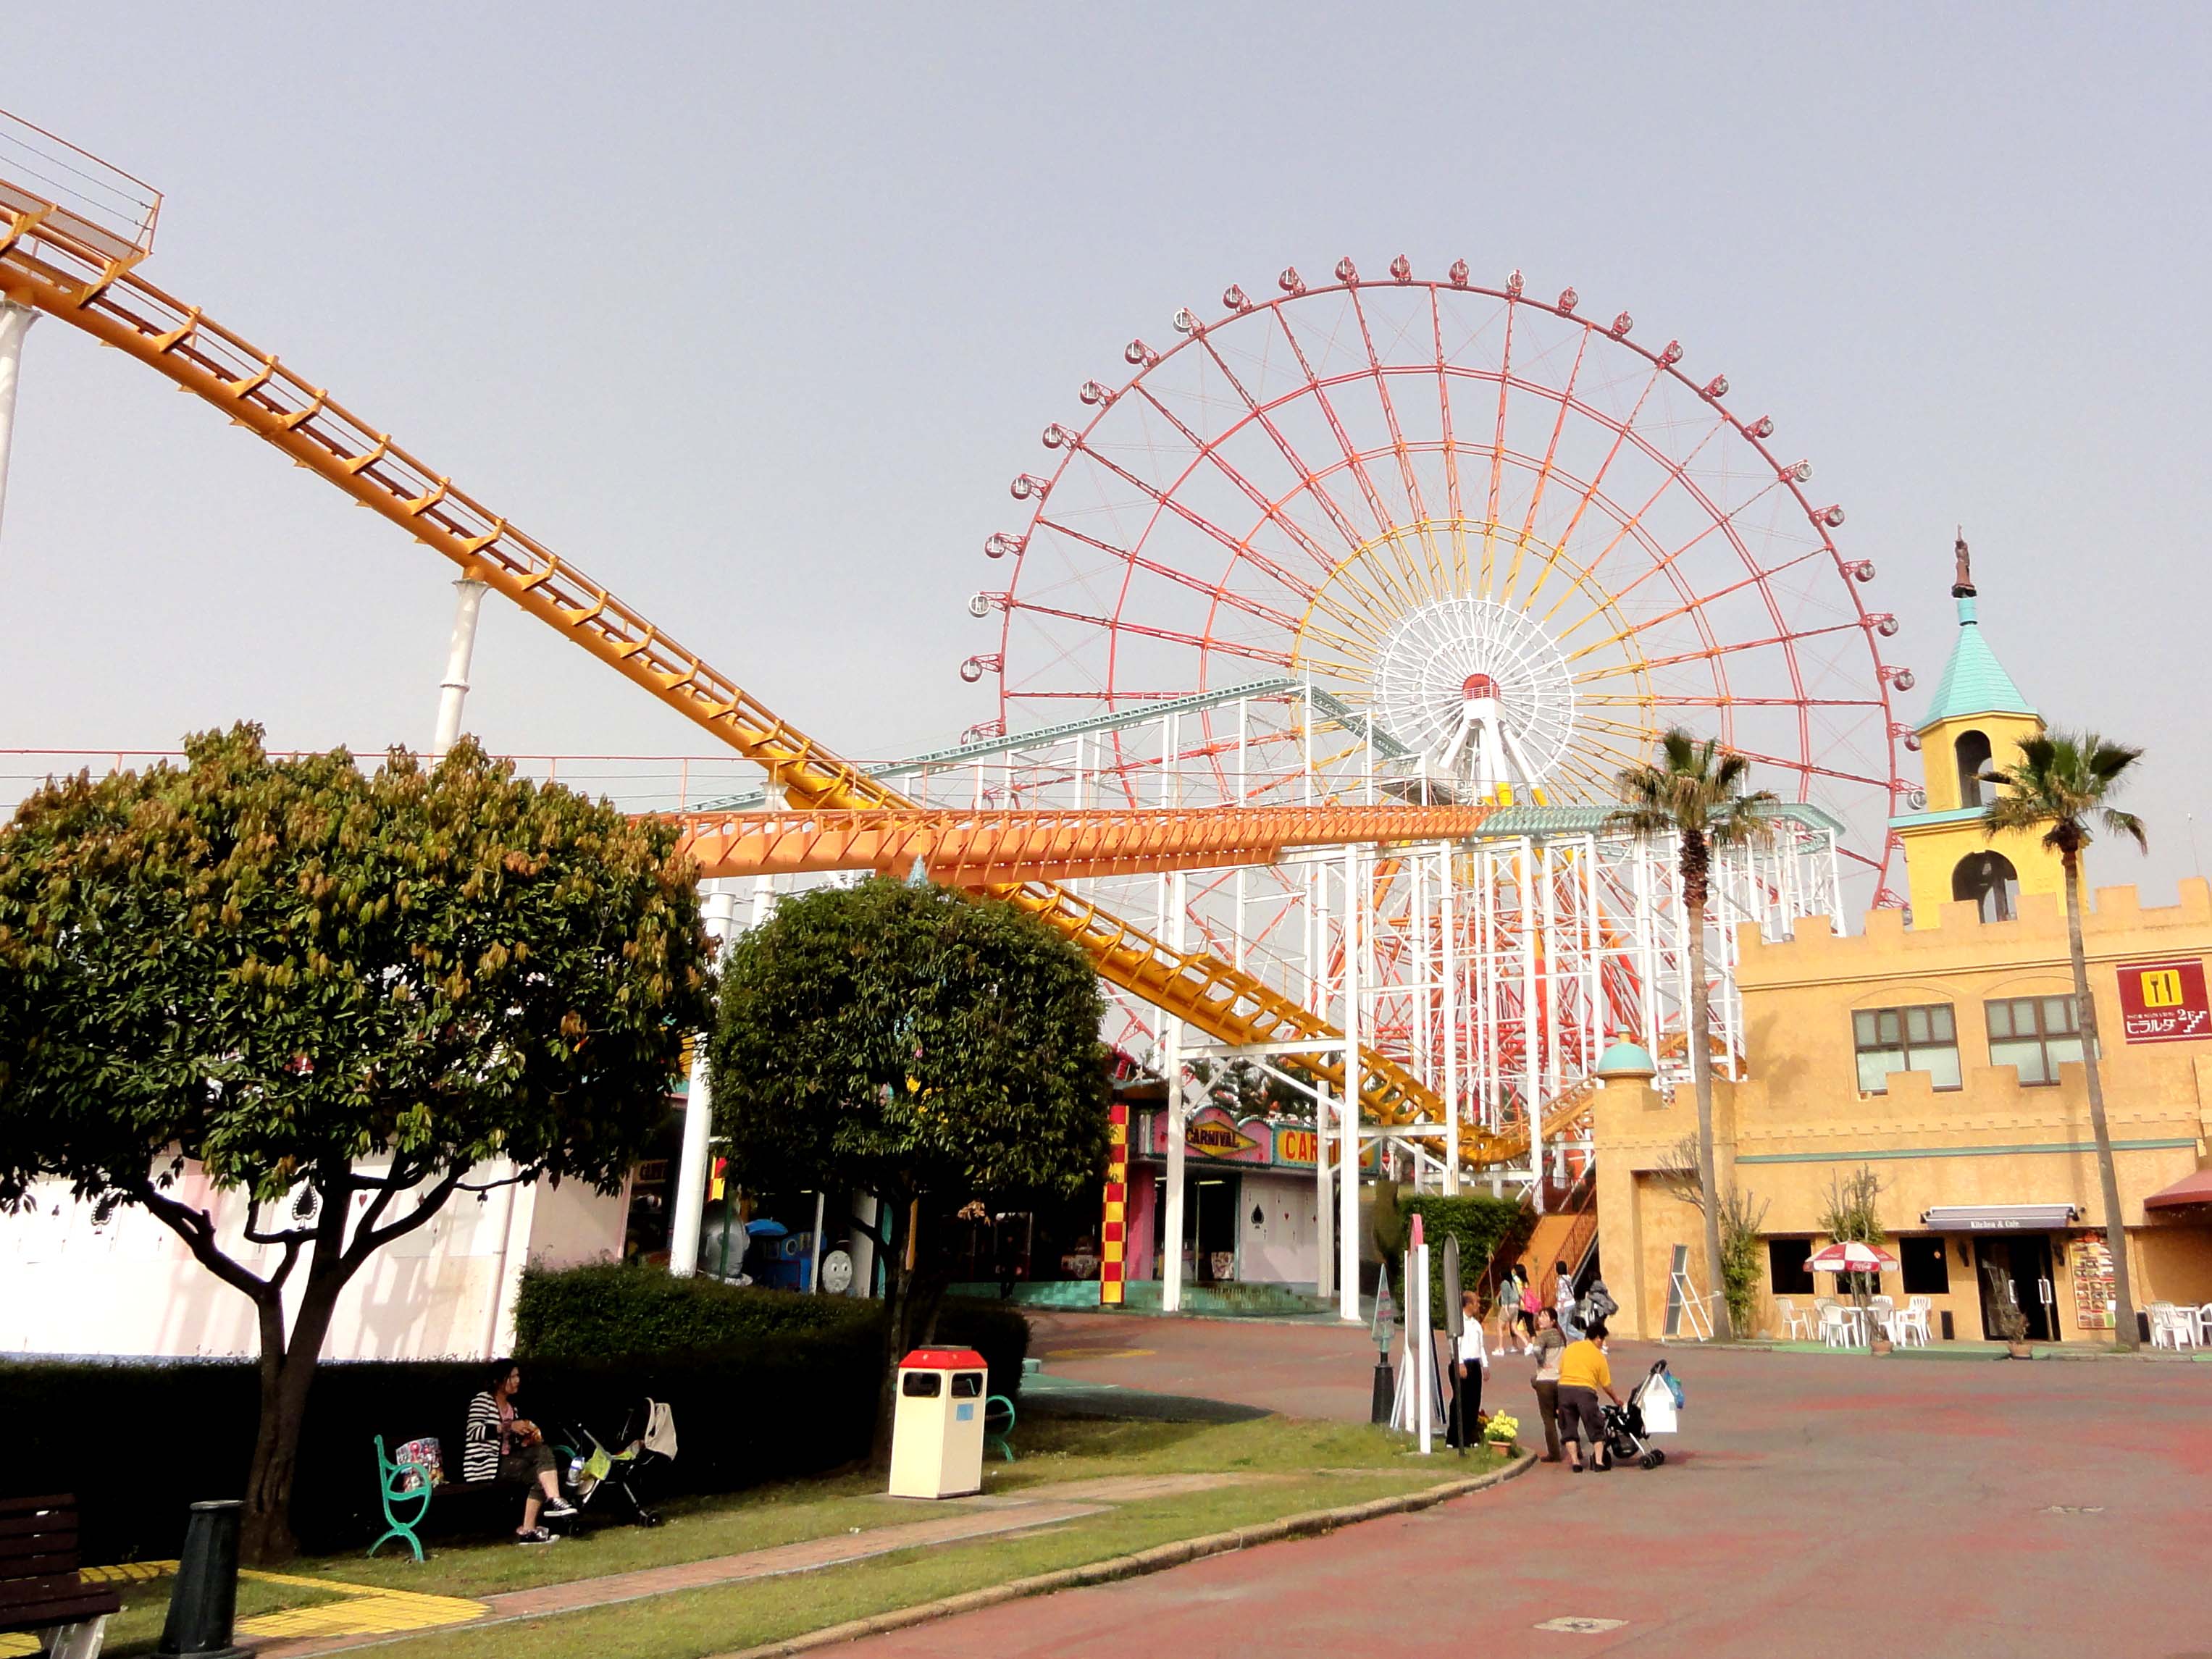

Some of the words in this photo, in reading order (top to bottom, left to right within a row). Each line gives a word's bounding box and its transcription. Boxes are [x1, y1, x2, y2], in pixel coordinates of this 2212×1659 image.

[2177, 1008, 2195, 1021] 2F
[1185, 1127, 1241, 1148] CARNIVAL
[1285, 1130, 1367, 1167] CARIL
[1971, 1220, 1995, 1229] Kitchen
